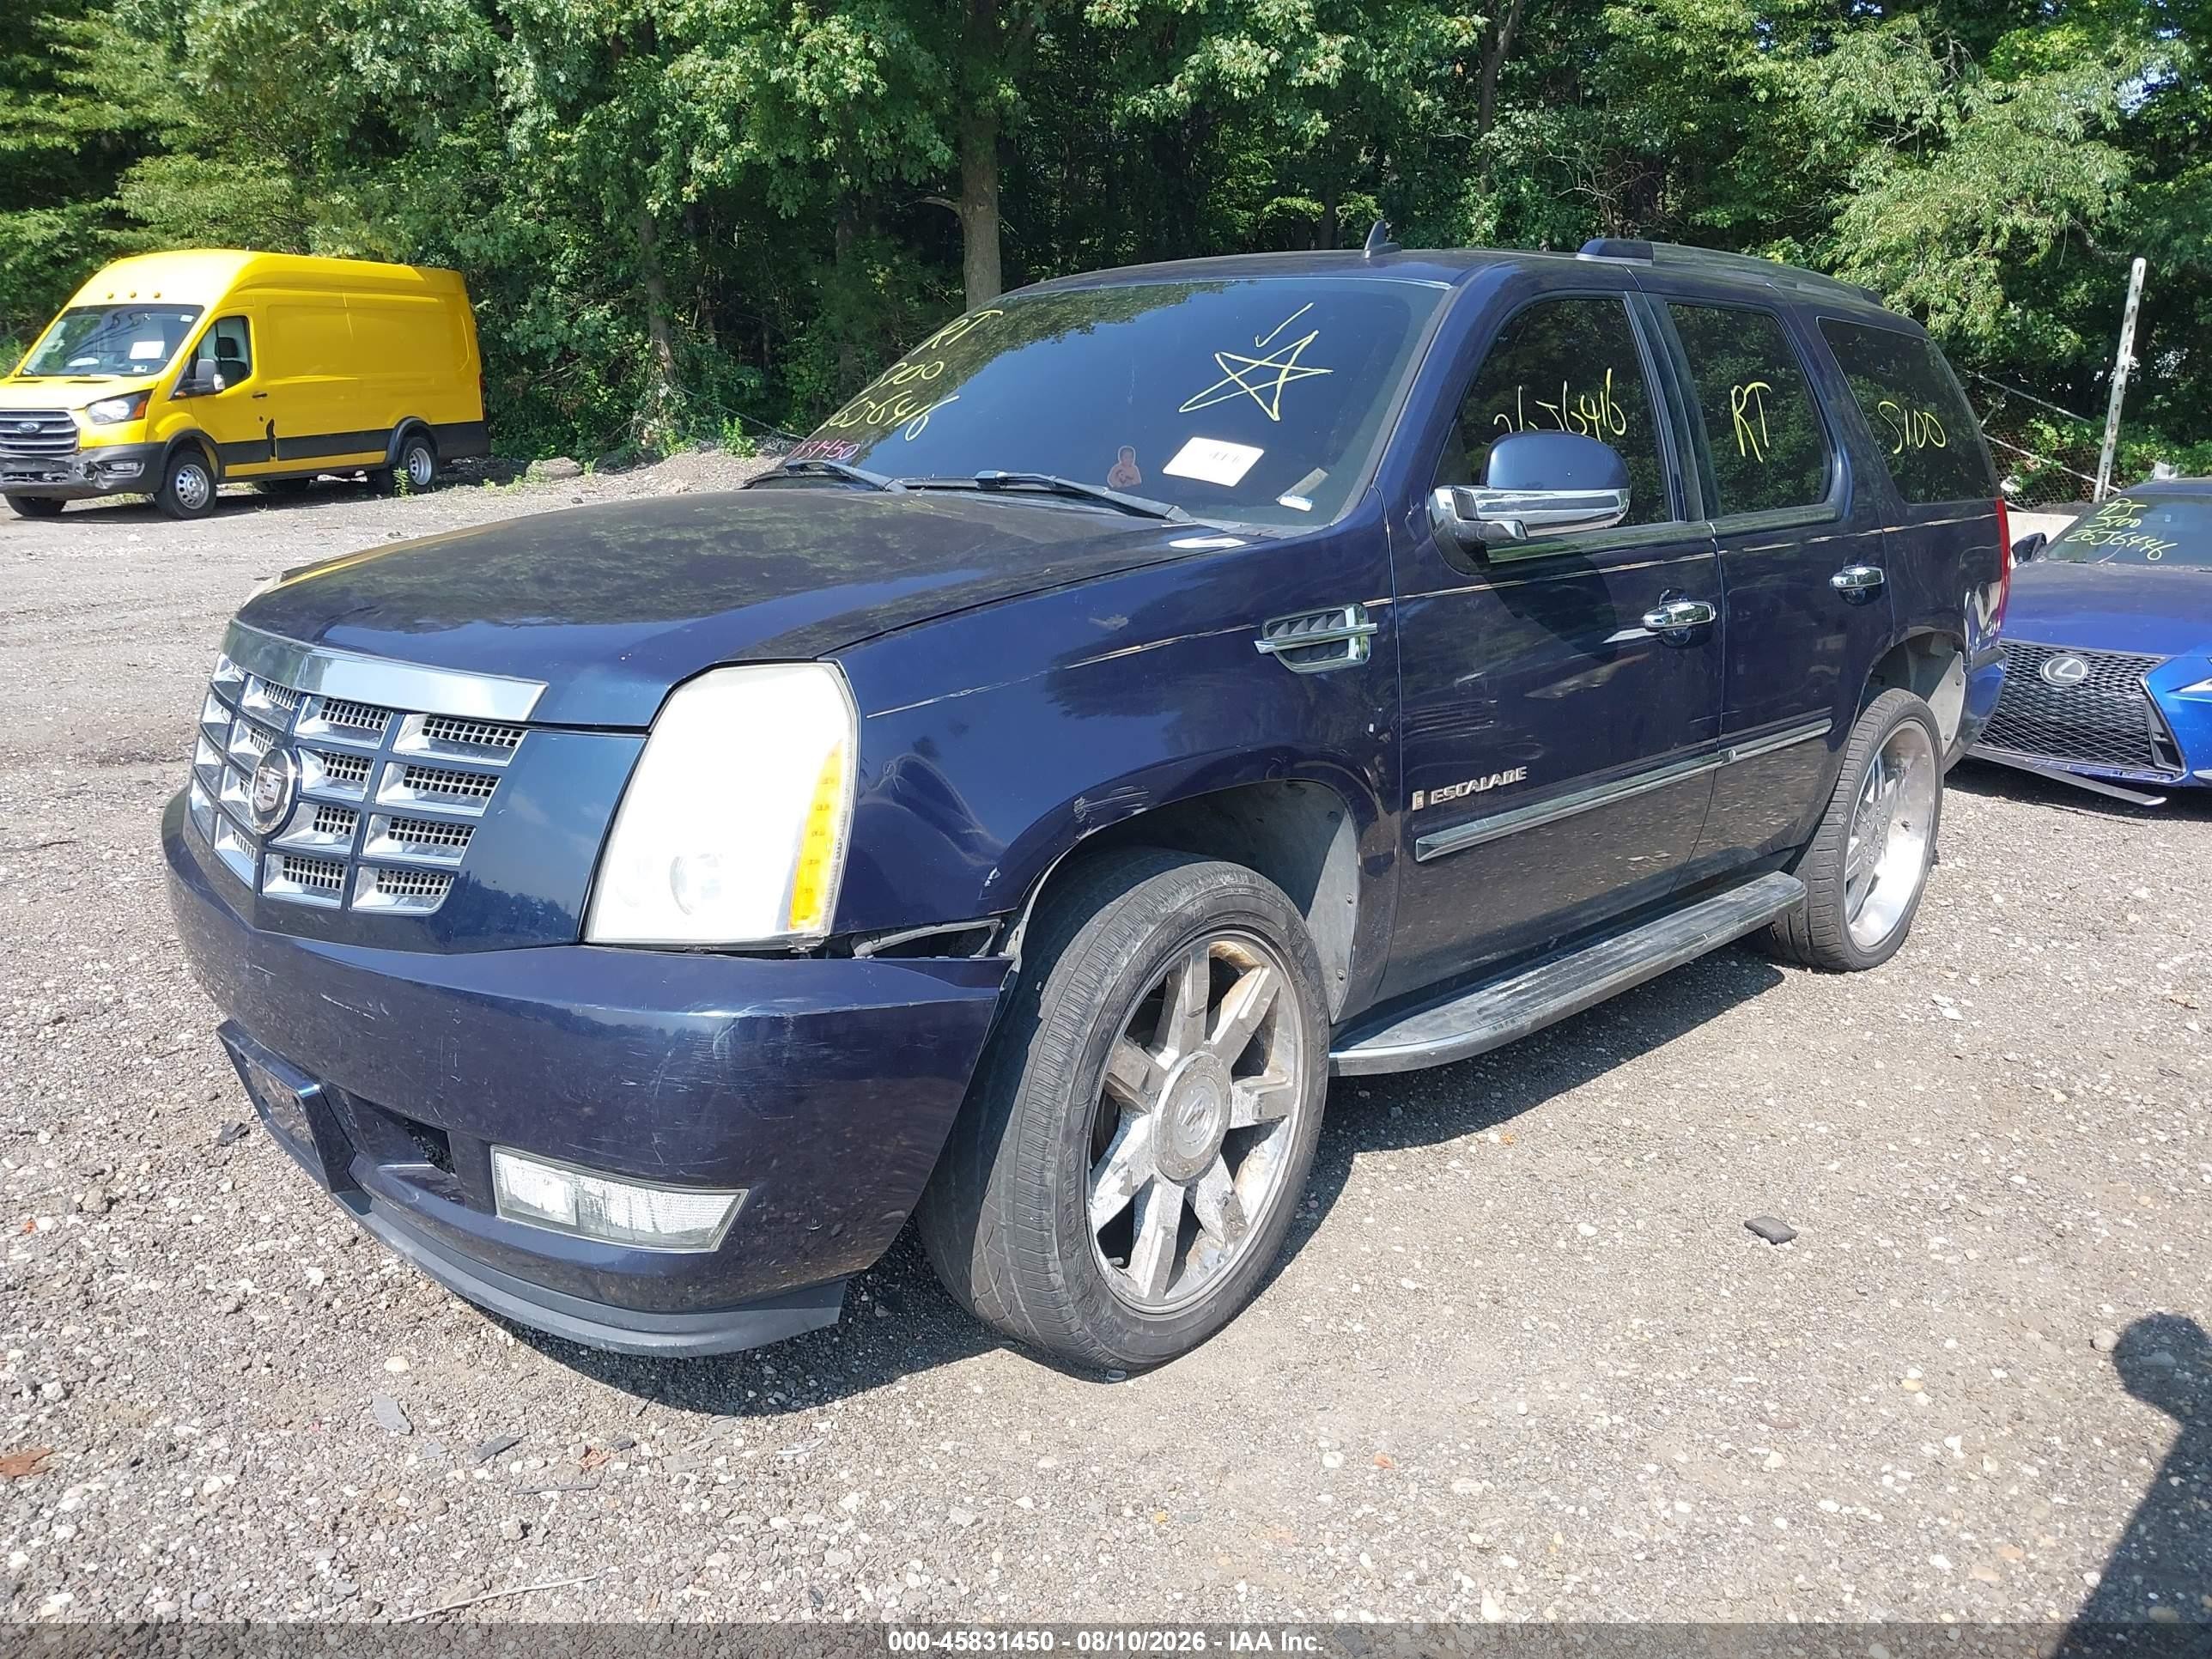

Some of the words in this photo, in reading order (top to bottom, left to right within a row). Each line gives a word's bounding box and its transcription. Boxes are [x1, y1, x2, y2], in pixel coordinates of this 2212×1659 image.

[912, 310, 1003, 356] RT
[1731, 382, 1772, 463] RT
[1878, 401, 1946, 454] S100
[1431, 766, 1528, 805] ESCALADE
